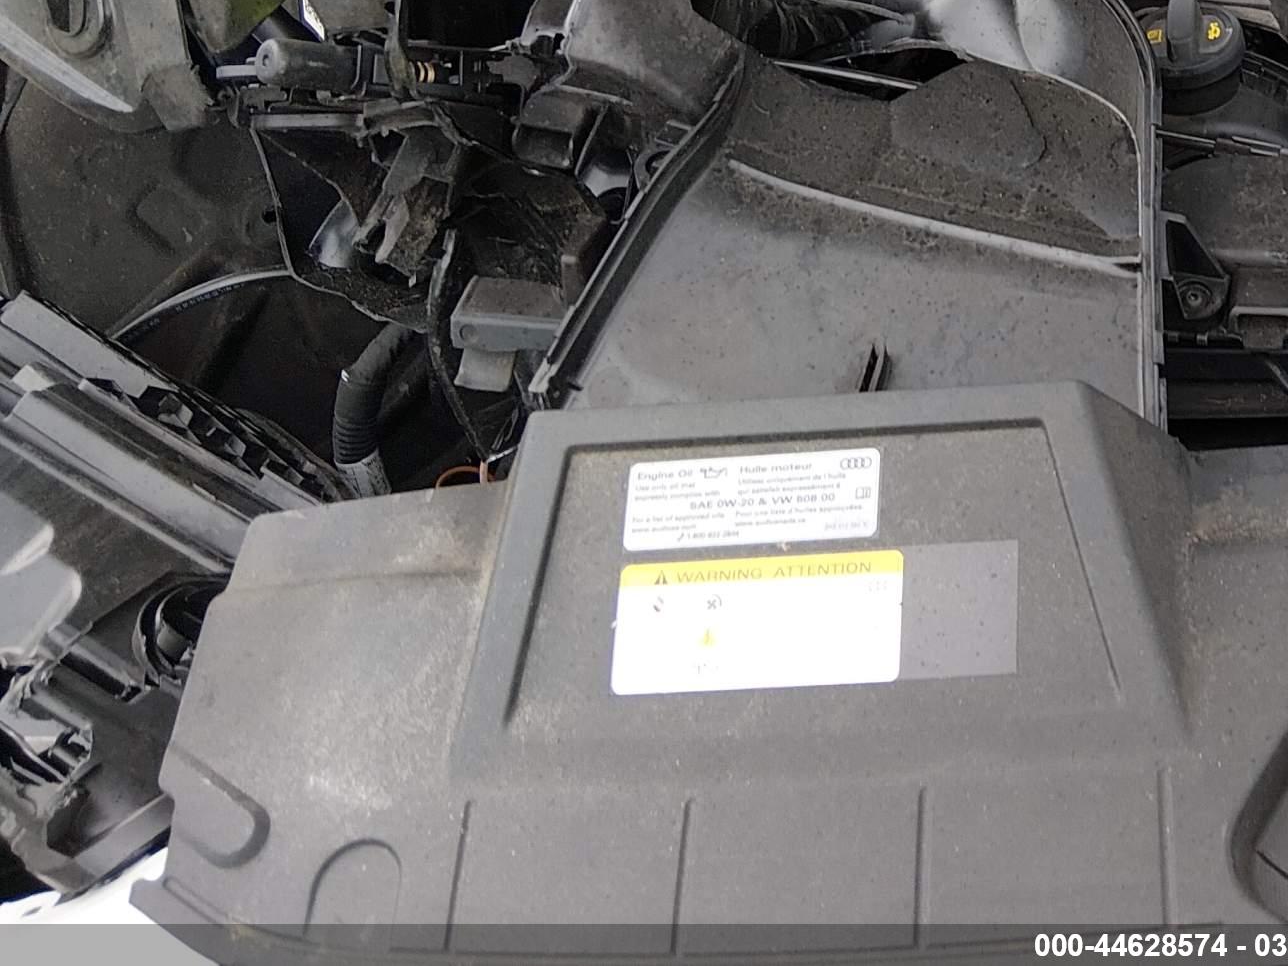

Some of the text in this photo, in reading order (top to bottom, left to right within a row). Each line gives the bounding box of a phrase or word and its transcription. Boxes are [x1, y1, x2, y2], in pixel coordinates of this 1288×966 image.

[637, 468, 693, 481] Engine Oil
[740, 463, 812, 474] Huile moteur
[690, 501, 713, 510] SAE
[758, 497, 767, 506] &
[772, 496, 793, 505] VW
[821, 493, 836, 502] 00
[676, 561, 872, 583] WARNING ATTENTION
